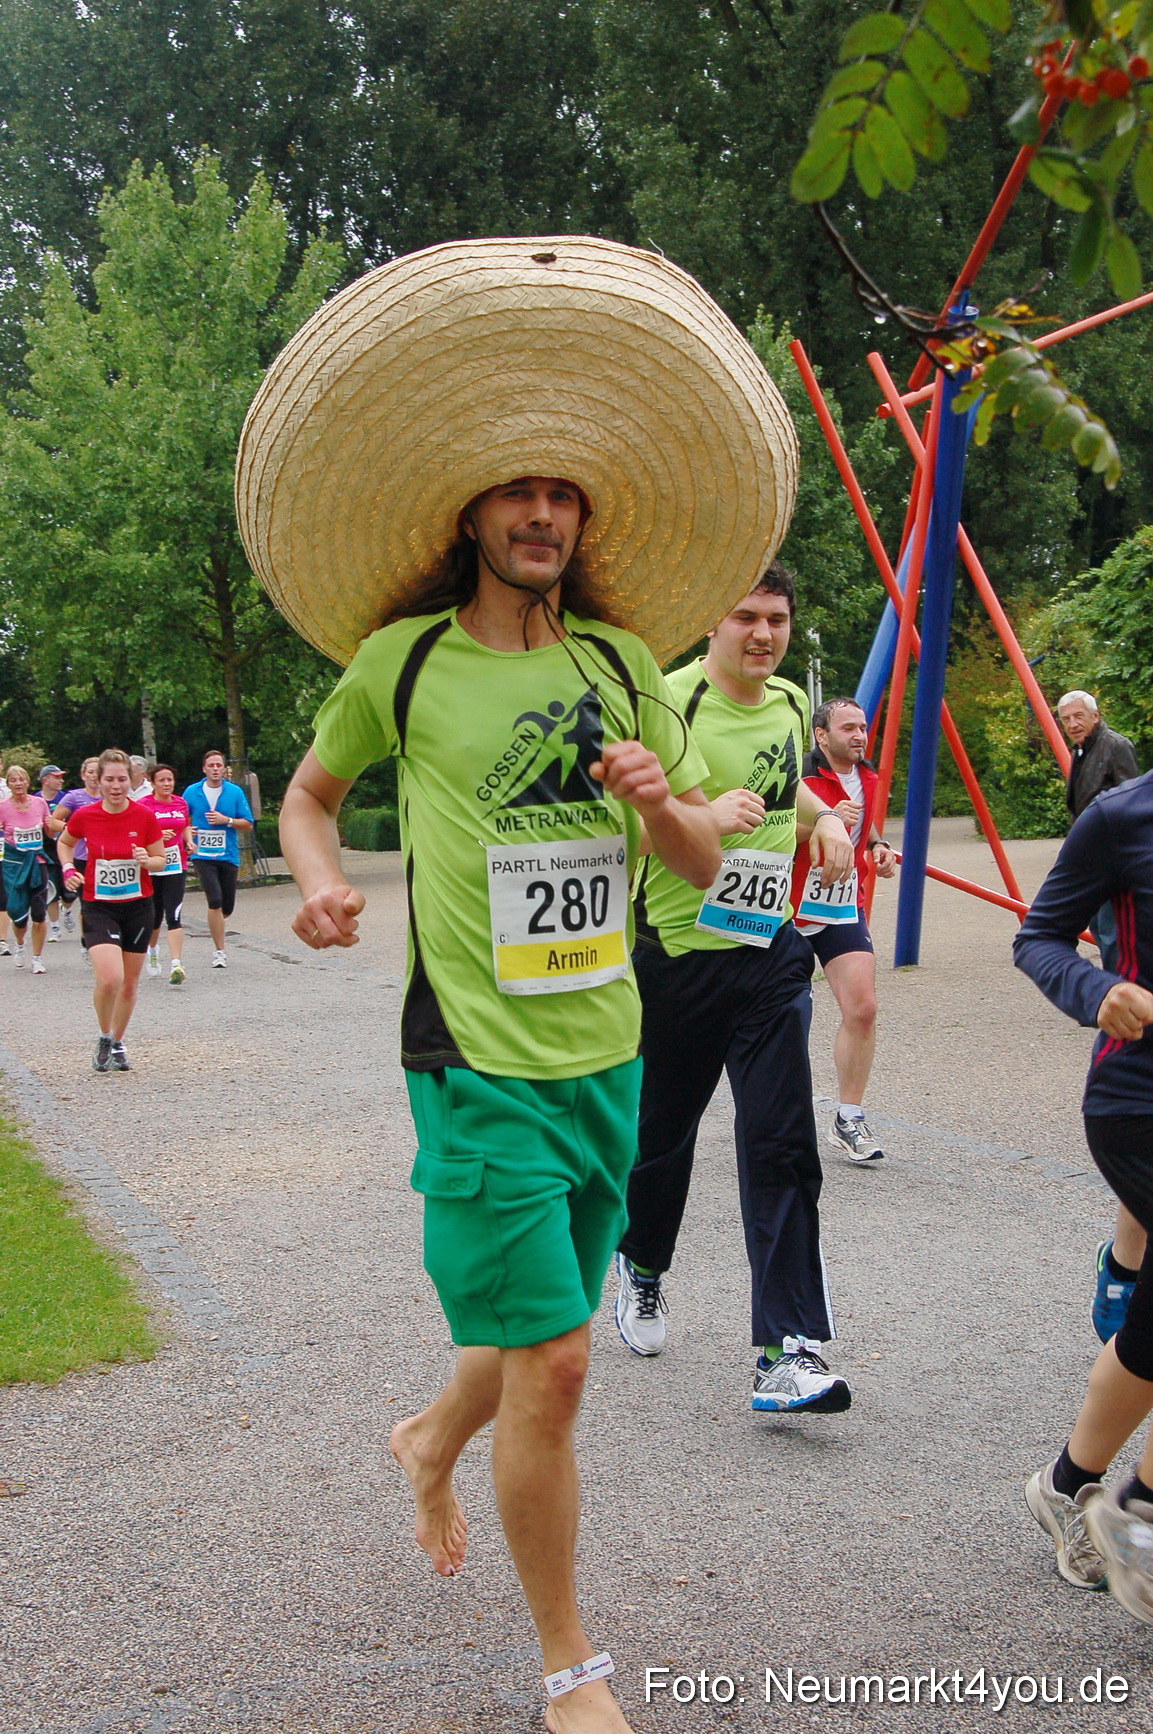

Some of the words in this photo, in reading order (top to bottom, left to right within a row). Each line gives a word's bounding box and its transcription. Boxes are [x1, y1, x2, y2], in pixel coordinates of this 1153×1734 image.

[476, 728, 537, 802] GOSSEN
[743, 763, 766, 791] SSEN
[495, 807, 608, 834] METRAWATT
[200, 836, 223, 847] 2429
[492, 859, 546, 874] PARTL
[550, 853, 613, 871] Neumarkt
[100, 867, 136, 886] 2309
[716, 871, 788, 912] 2462
[809, 880, 853, 904] 3111
[526, 875, 610, 935] 280
[726, 914, 773, 935] Roman
[546, 946, 598, 971] Armin
